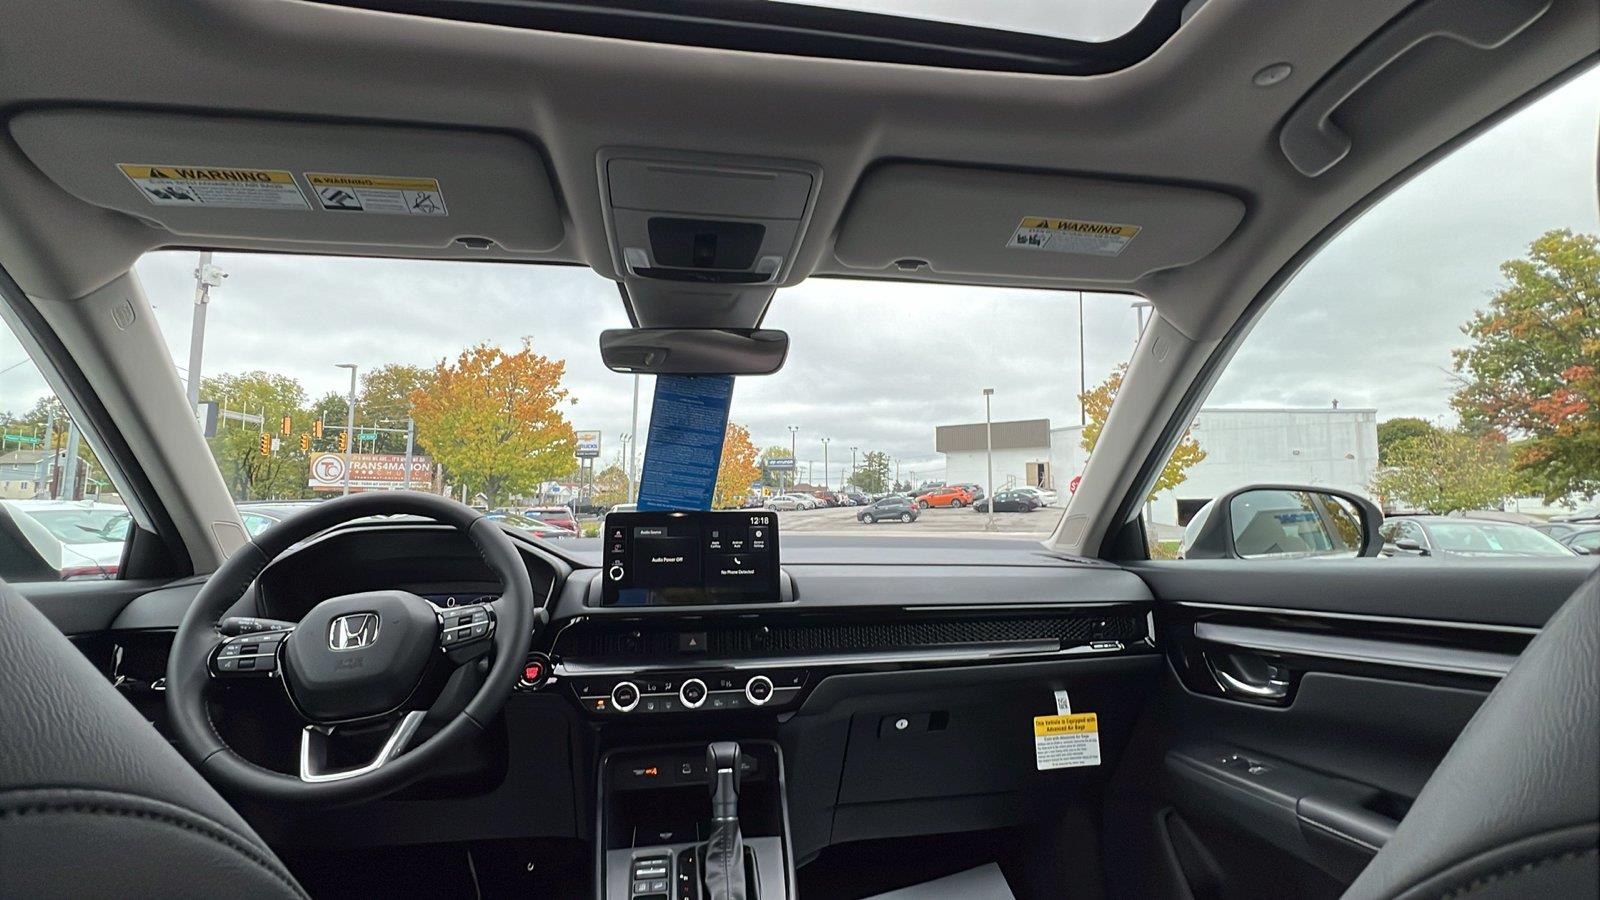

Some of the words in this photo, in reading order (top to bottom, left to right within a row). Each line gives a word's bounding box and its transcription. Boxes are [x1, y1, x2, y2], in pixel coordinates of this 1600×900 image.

[174, 169, 272, 182] WARNING
[322, 178, 373, 186] WARNING
[1057, 221, 1122, 235] WARNING
[349, 461, 430, 471] TRANS4MAION
[750, 516, 769, 525] 12:18
